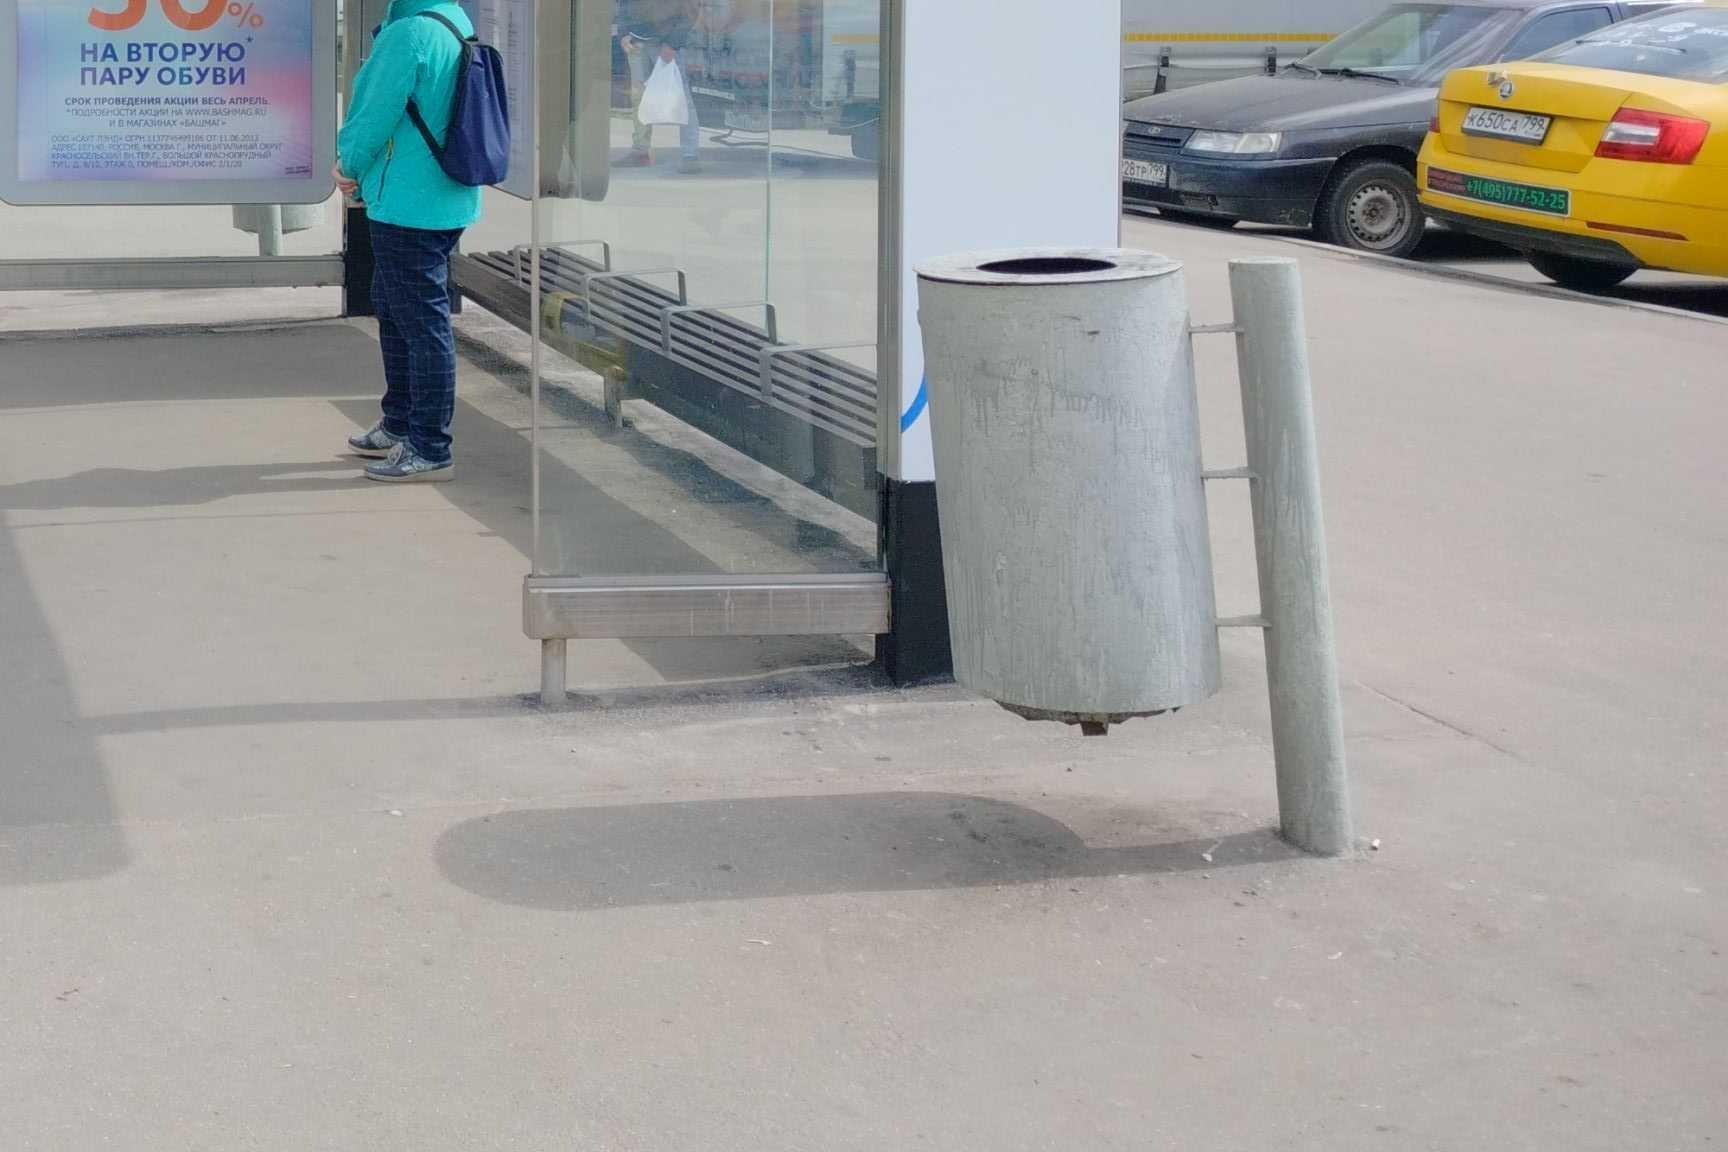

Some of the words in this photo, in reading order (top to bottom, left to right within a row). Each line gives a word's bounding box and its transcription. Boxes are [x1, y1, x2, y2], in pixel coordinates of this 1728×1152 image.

[80, 42, 119, 63] НА
[80, 66, 150, 87] ПАРУ
[156, 66, 246, 86] ОБУВИ
[65, 97, 92, 106] СРОК
[94, 97, 161, 107] ПРОВЕДЕНИЯ
[165, 97, 199, 106] АКЦИИ
[202, 96, 226, 105] ВЕСЬ
[126, 119, 177, 128] МАГАЗИНАХ
